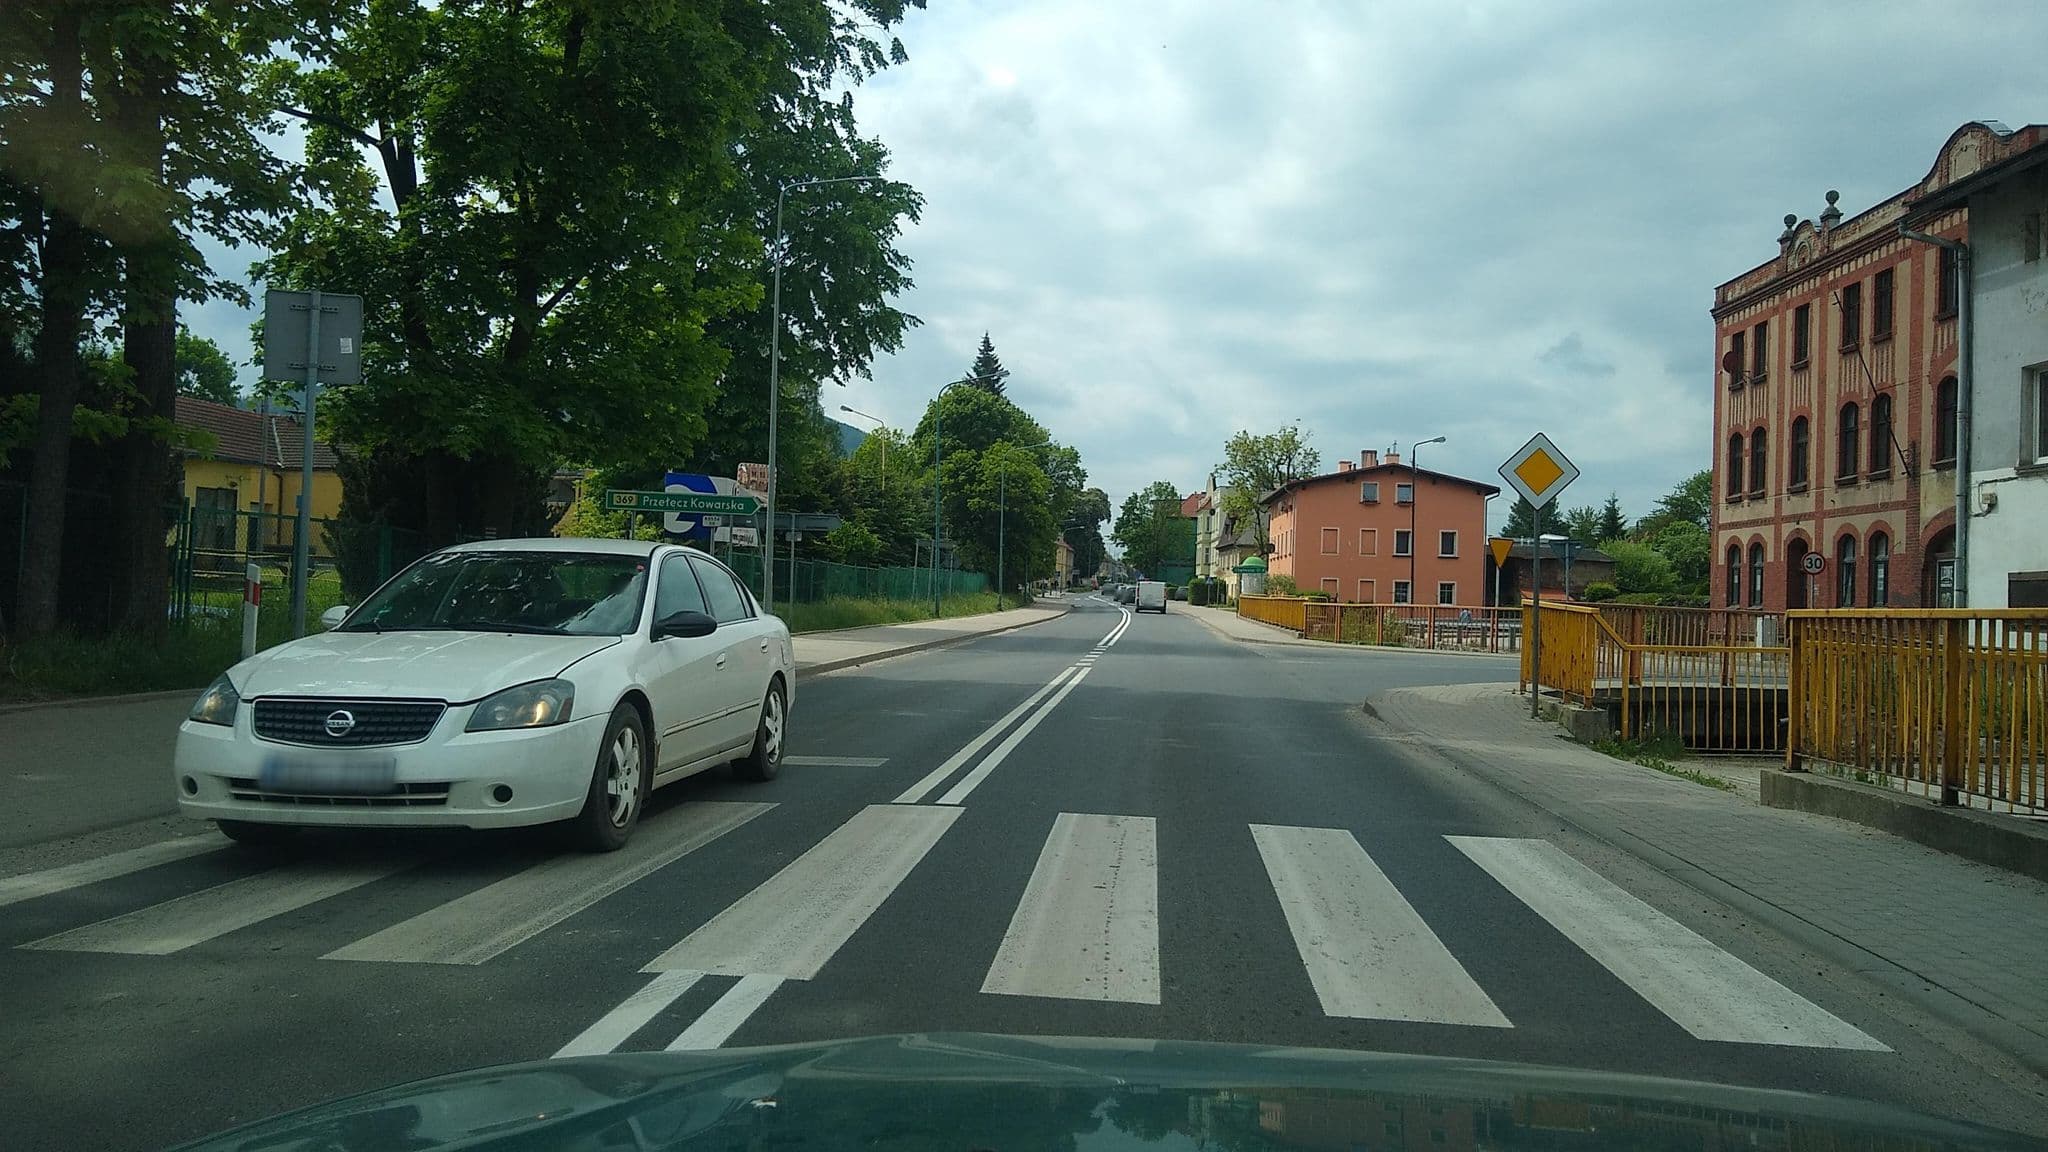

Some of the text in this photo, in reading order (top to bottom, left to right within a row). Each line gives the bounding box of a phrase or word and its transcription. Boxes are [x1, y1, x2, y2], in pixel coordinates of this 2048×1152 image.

[615, 495, 634, 504] 369
[691, 497, 744, 510] Kowarska
[1805, 557, 1823, 569] 30
